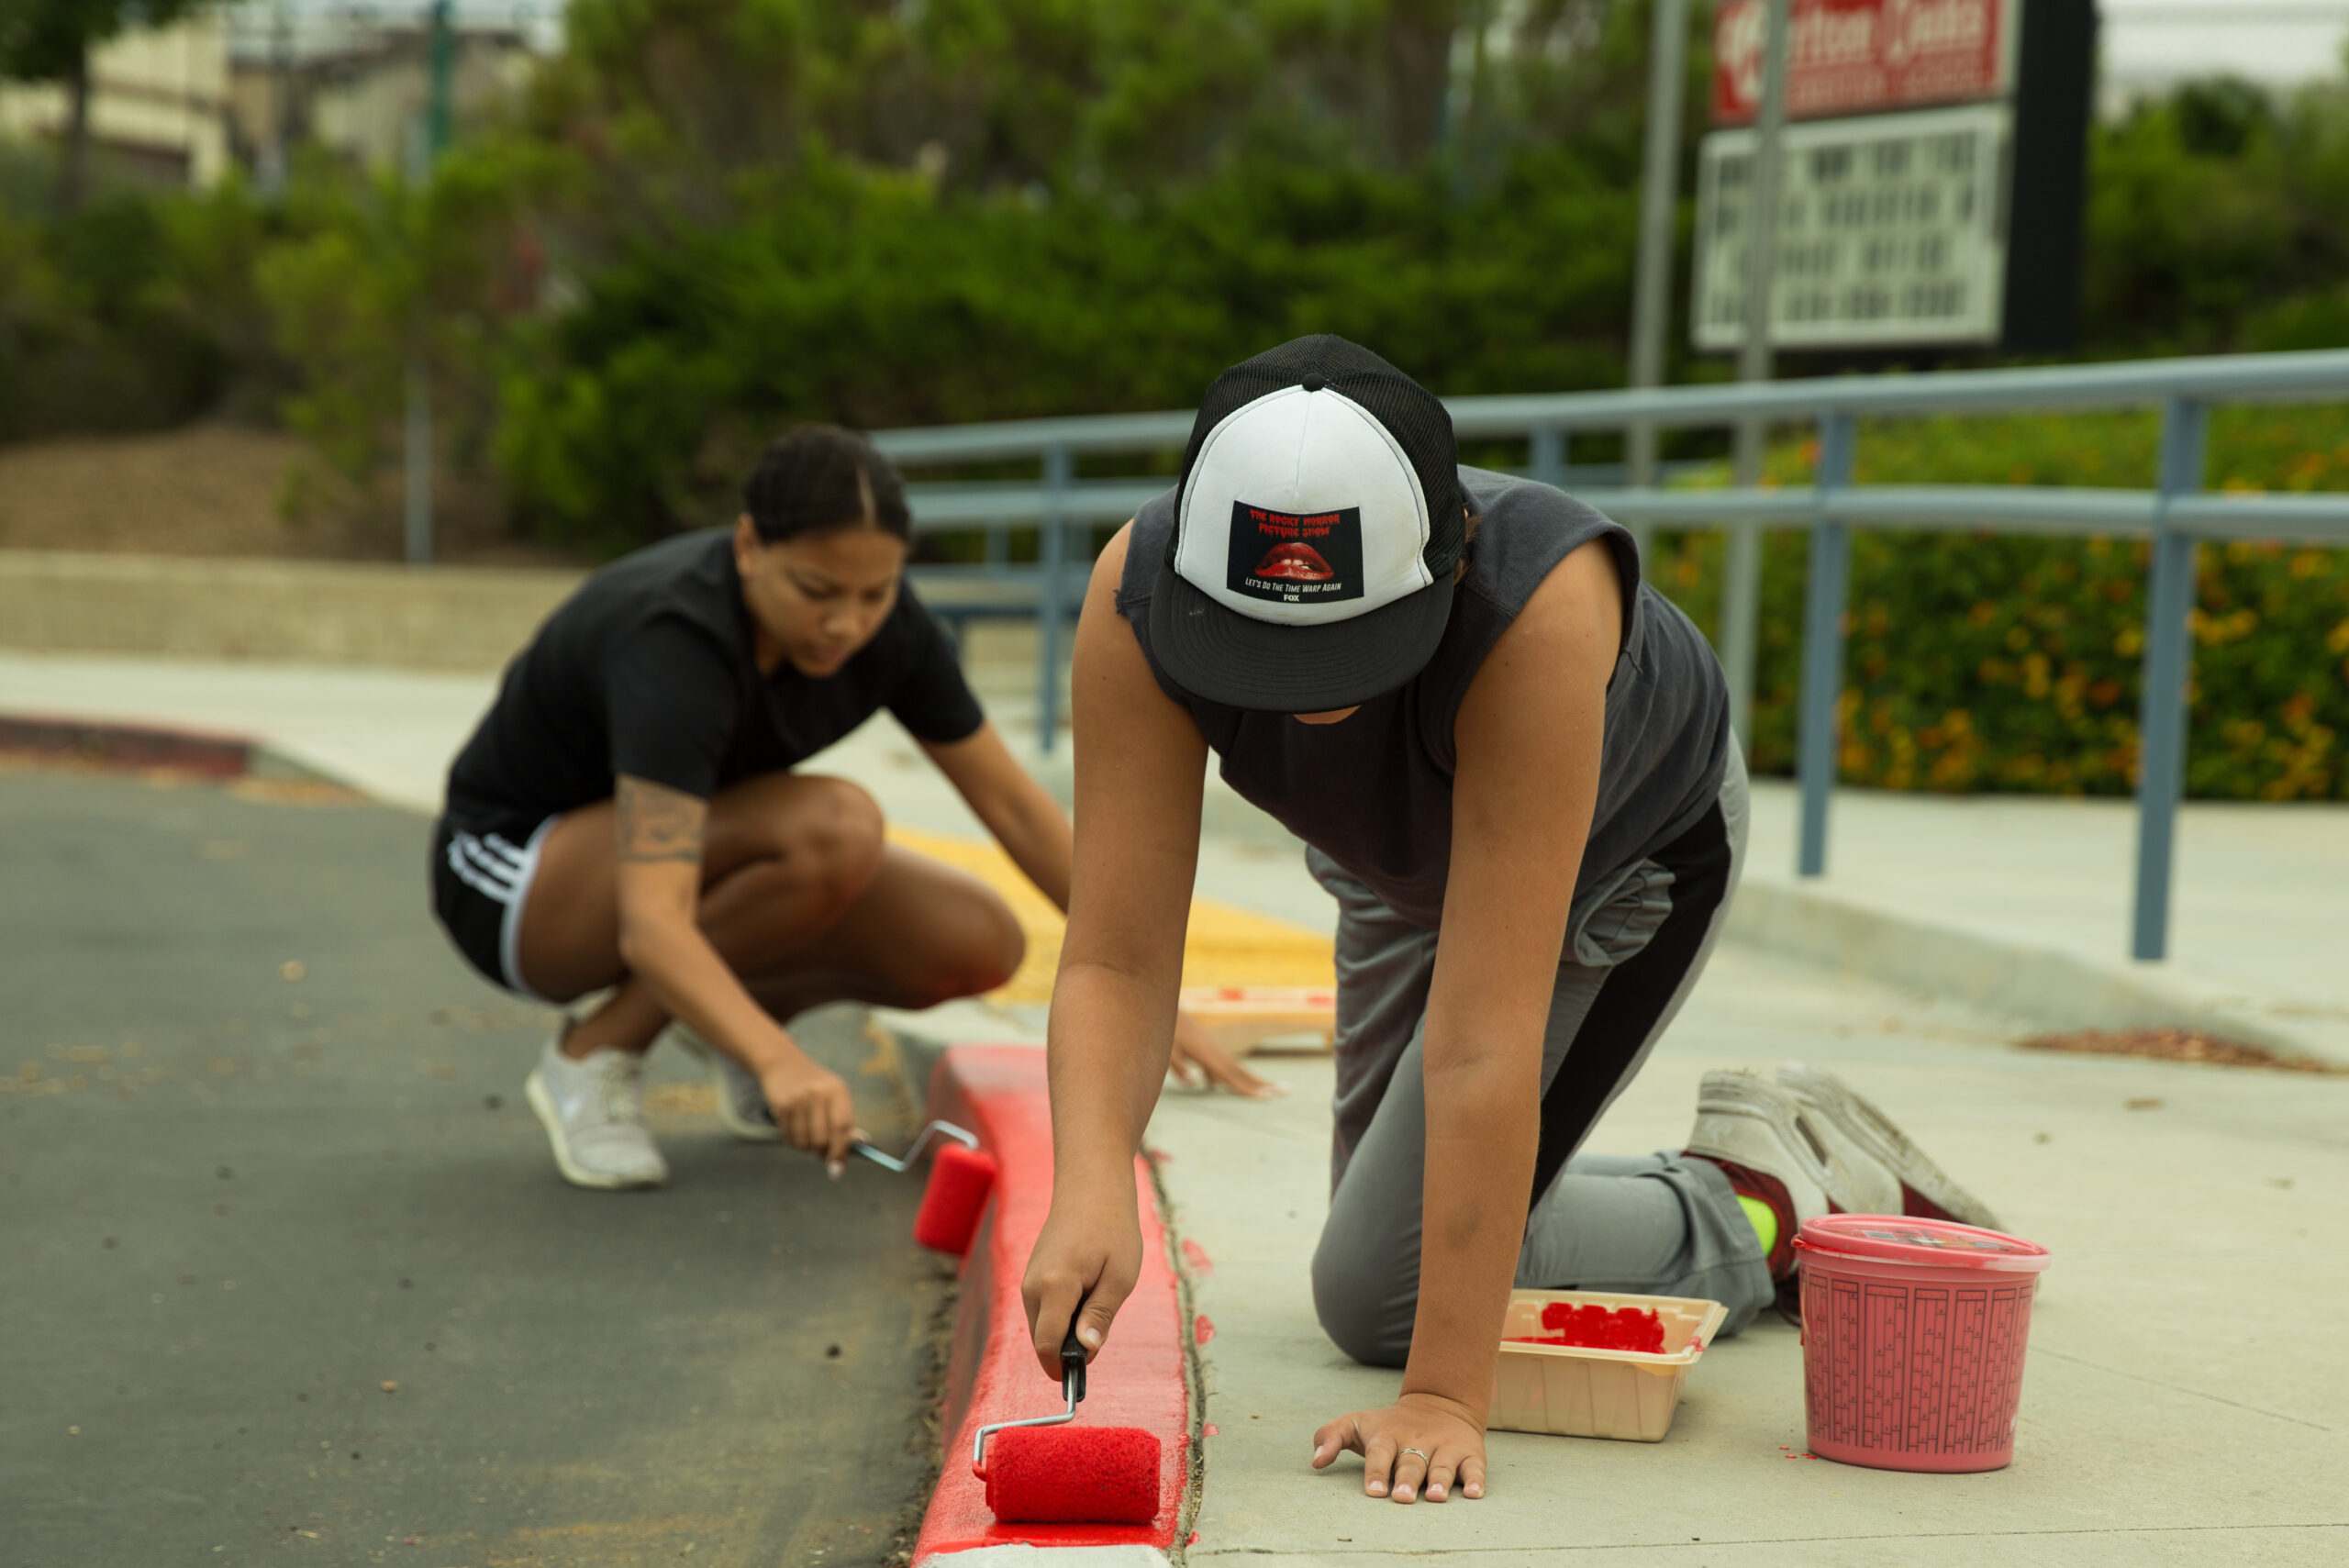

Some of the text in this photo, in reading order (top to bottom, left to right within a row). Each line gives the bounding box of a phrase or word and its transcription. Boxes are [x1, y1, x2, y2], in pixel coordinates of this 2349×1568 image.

[1249, 508, 1340, 528] THE ROCKY HORROR
[1259, 522, 1330, 539] PICTURE SHOW
[1245, 577, 1341, 593] LET'S DO THE TIME WARP AGAIN
